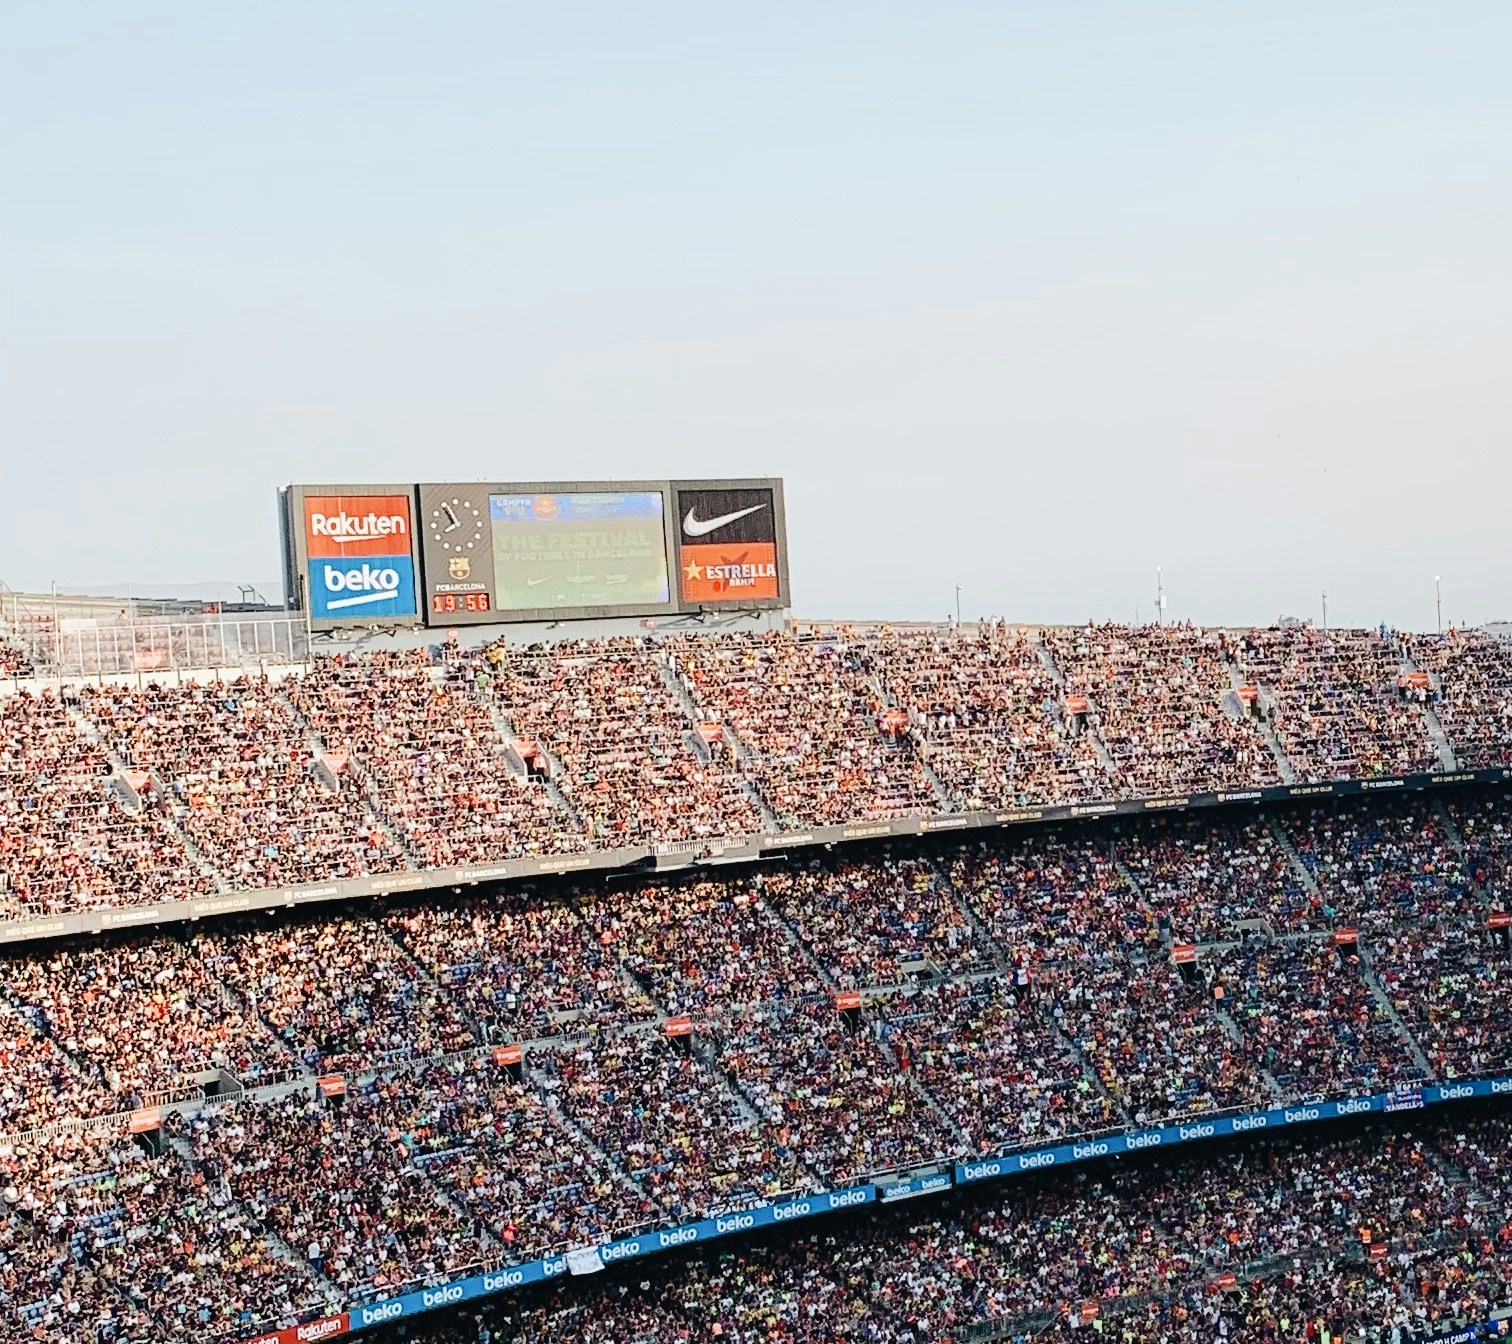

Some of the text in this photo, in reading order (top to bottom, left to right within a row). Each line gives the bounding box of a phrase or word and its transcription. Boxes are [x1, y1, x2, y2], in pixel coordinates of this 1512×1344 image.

[311, 512, 406, 536] Rakuten
[324, 564, 400, 592] beko
[705, 564, 776, 580] ESTRELLA
[434, 594, 489, 613] 19:56
[1376, 779, 1404, 787] BARCELONA
[1440, 1086, 1474, 1100] beko
[1285, 1107, 1319, 1123] beko
[1337, 1100, 1371, 1115] beko
[1233, 1115, 1266, 1131] beko
[1180, 1124, 1214, 1140] beko
[1126, 1133, 1161, 1149] beko
[1073, 1142, 1108, 1159] beko
[1020, 1153, 1055, 1169] beko
[964, 1163, 1000, 1180] beko
[888, 1184, 911, 1197] beko
[921, 1176, 945, 1189] beko
[830, 1189, 866, 1208] beko
[773, 1201, 810, 1220] beko
[717, 1216, 754, 1234] beko
[660, 1228, 698, 1247] beko
[602, 1241, 640, 1261] beko
[484, 1271, 523, 1291] beko
[423, 1286, 463, 1308] beko
[362, 1301, 403, 1325] beko
[297, 1319, 342, 1340] Rakuten
